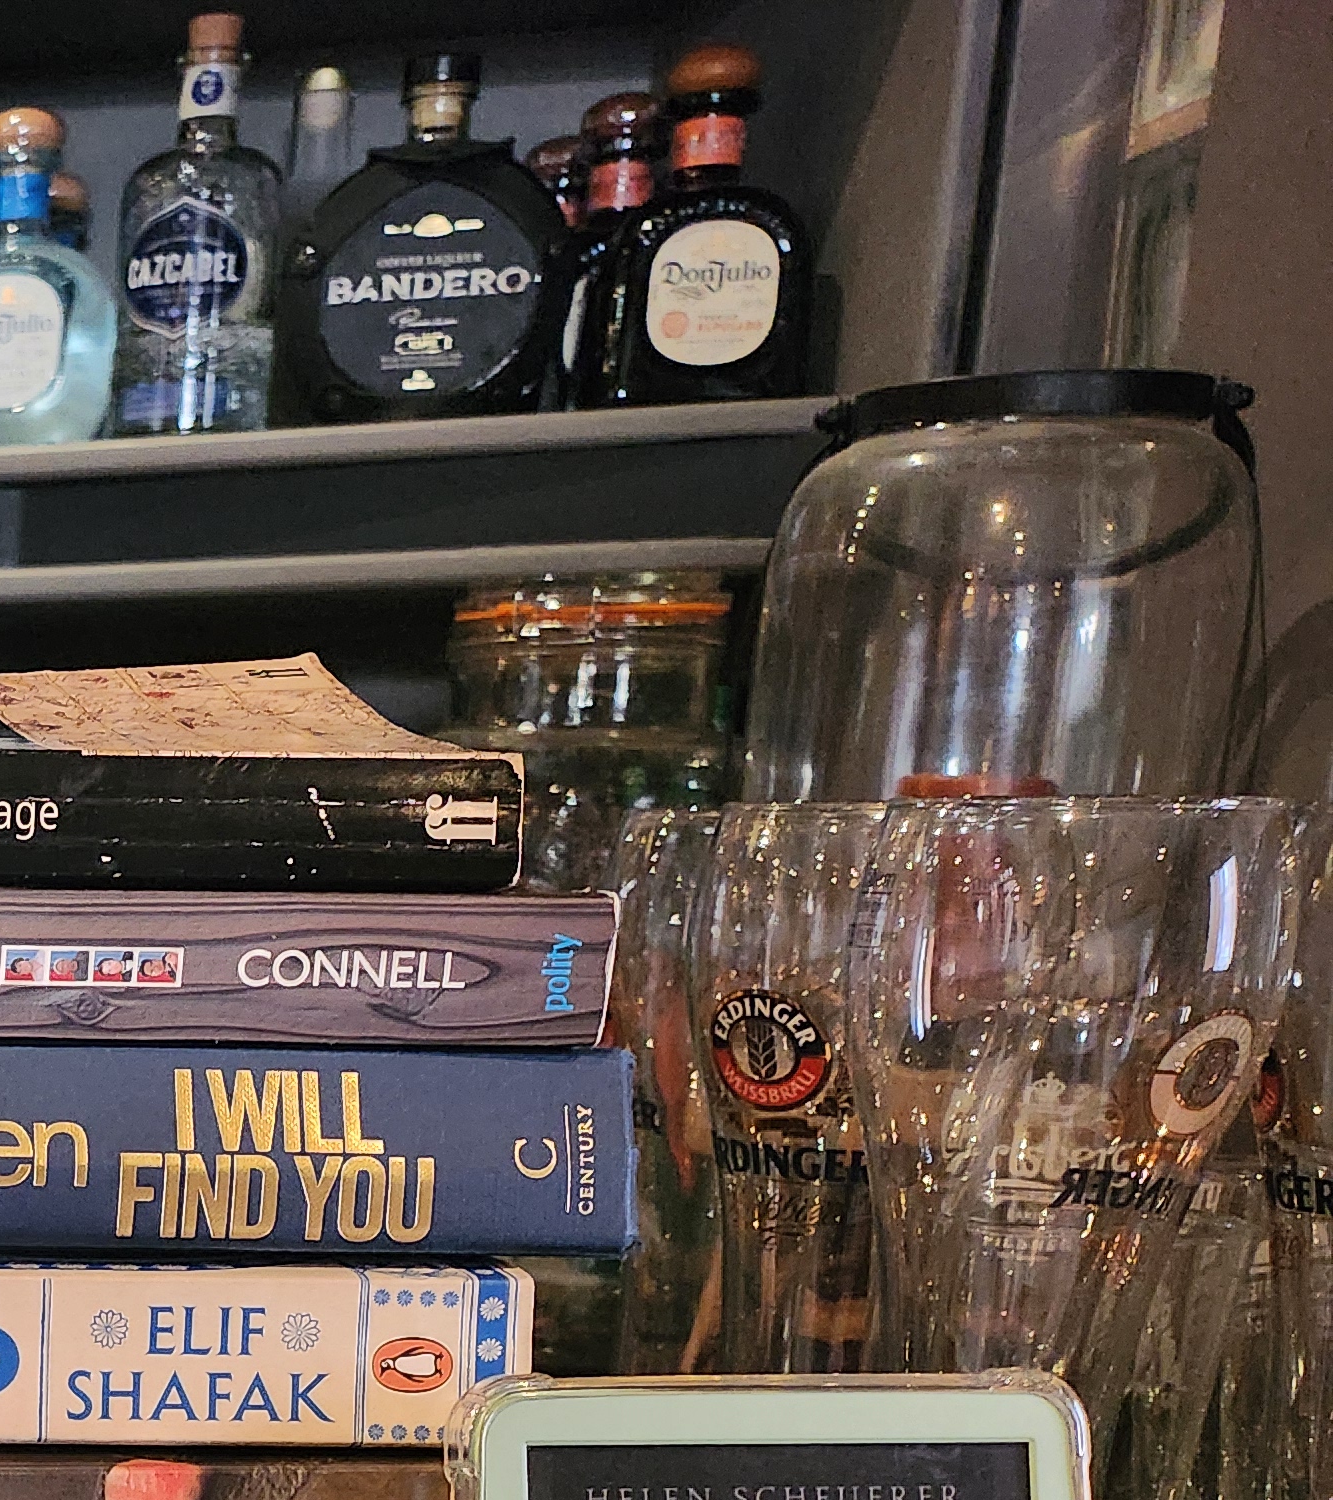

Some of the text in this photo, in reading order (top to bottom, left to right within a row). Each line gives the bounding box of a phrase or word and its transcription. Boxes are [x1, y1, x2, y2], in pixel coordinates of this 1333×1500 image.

[127, 250, 240, 290] CAZCABEL
[326, 265, 531, 305] BANDERO
[236, 947, 466, 991] CONNELL
[544, 933, 583, 1012] polity
[713, 996, 817, 1047] ERDINGER
[173, 1068, 385, 1155] I WILL
[577, 1103, 595, 1216] CENTURY
[115, 1153, 435, 1244] FIND YOU
[145, 1306, 268, 1357] ELIF
[66, 1371, 335, 1424] SHAFAK
